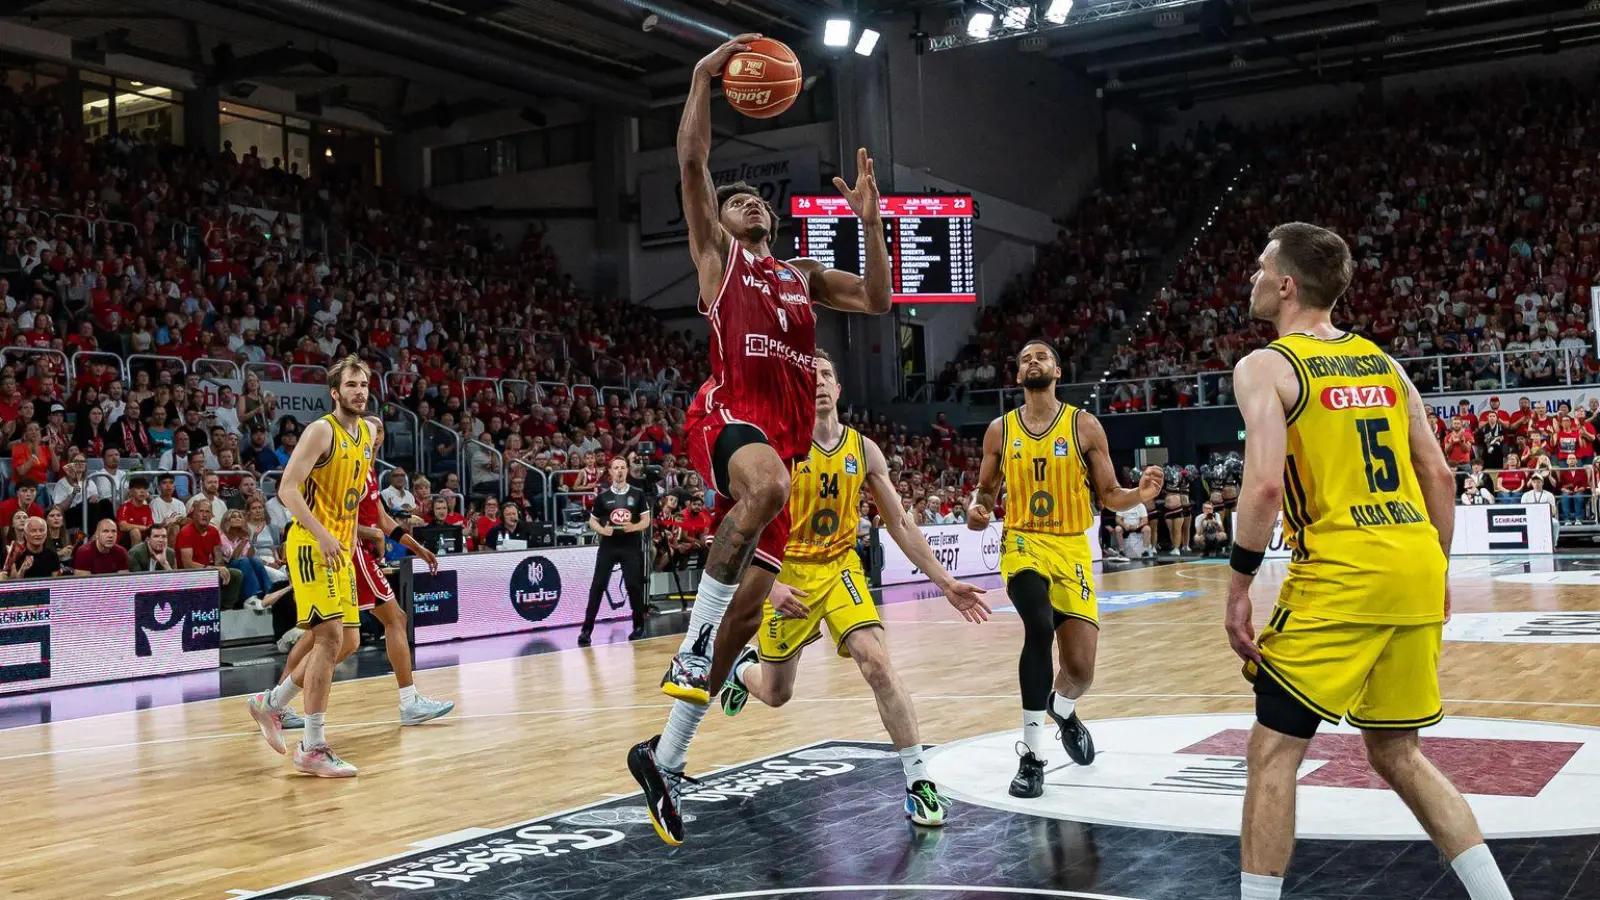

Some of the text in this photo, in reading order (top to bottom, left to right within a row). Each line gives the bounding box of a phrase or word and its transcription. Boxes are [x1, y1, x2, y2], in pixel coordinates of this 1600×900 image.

[725, 88, 771, 105] Baden
[739, 160, 790, 180] TECHNIK
[798, 199, 811, 209] 26
[953, 199, 966, 209] 23
[776, 307, 788, 332] 8
[1355, 417, 1400, 494] 15
[1033, 457, 1047, 482] 17
[819, 472, 840, 500] 34
[1350, 503, 1392, 528] ALBA
[514, 587, 558, 604] fuchs
[766, 616, 779, 639] inte
[354, 838, 514, 882] BAMBERG
